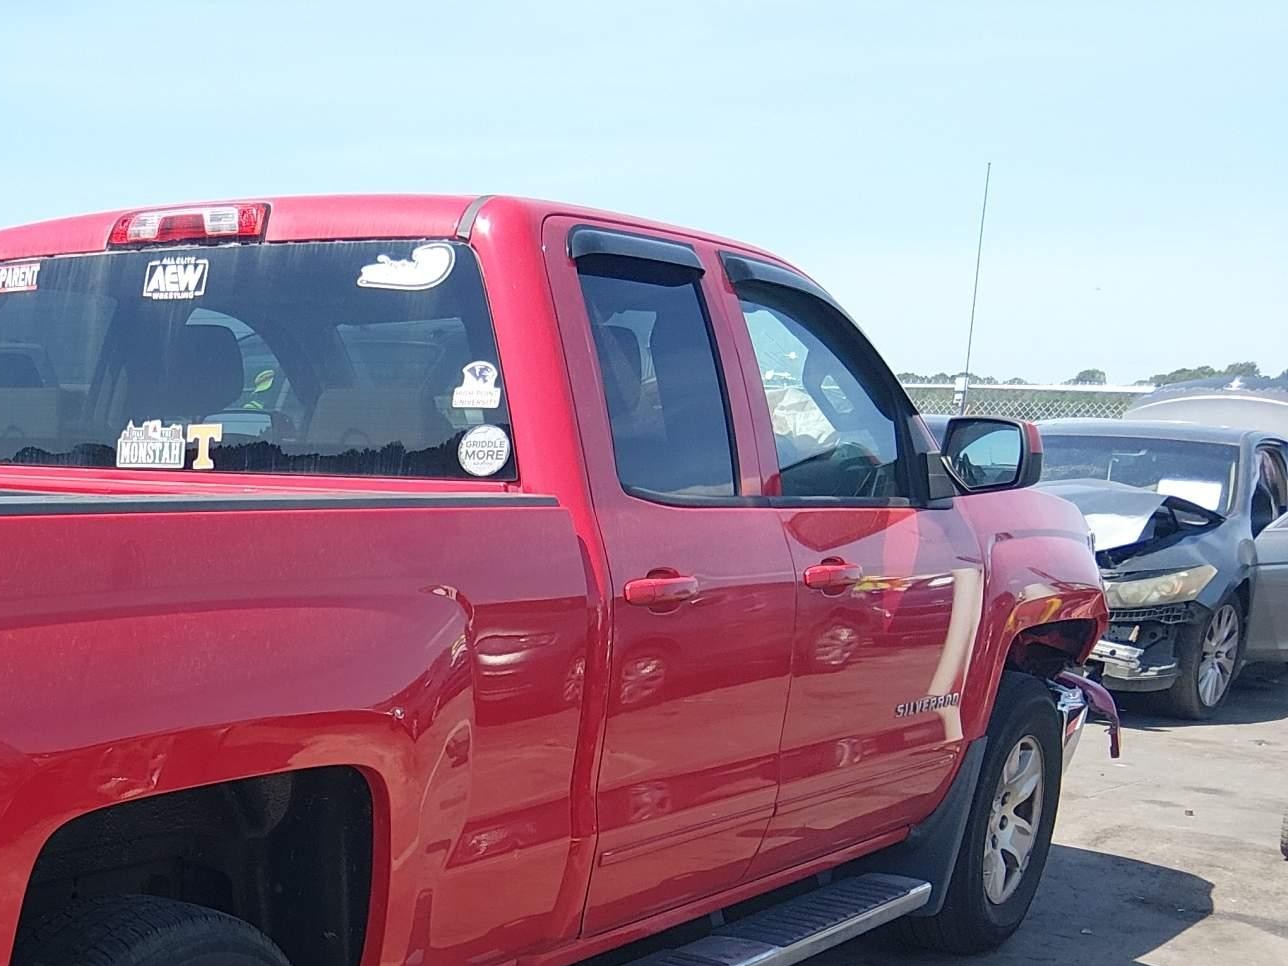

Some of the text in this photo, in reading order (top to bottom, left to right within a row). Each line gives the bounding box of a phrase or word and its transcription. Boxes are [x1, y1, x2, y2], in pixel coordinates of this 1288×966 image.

[147, 264, 204, 292] AEW
[120, 441, 181, 464] MONSTAH
[464, 449, 505, 461] MORE
[465, 440, 505, 449] GRIDDLE
[894, 692, 960, 719] SILVERADO
